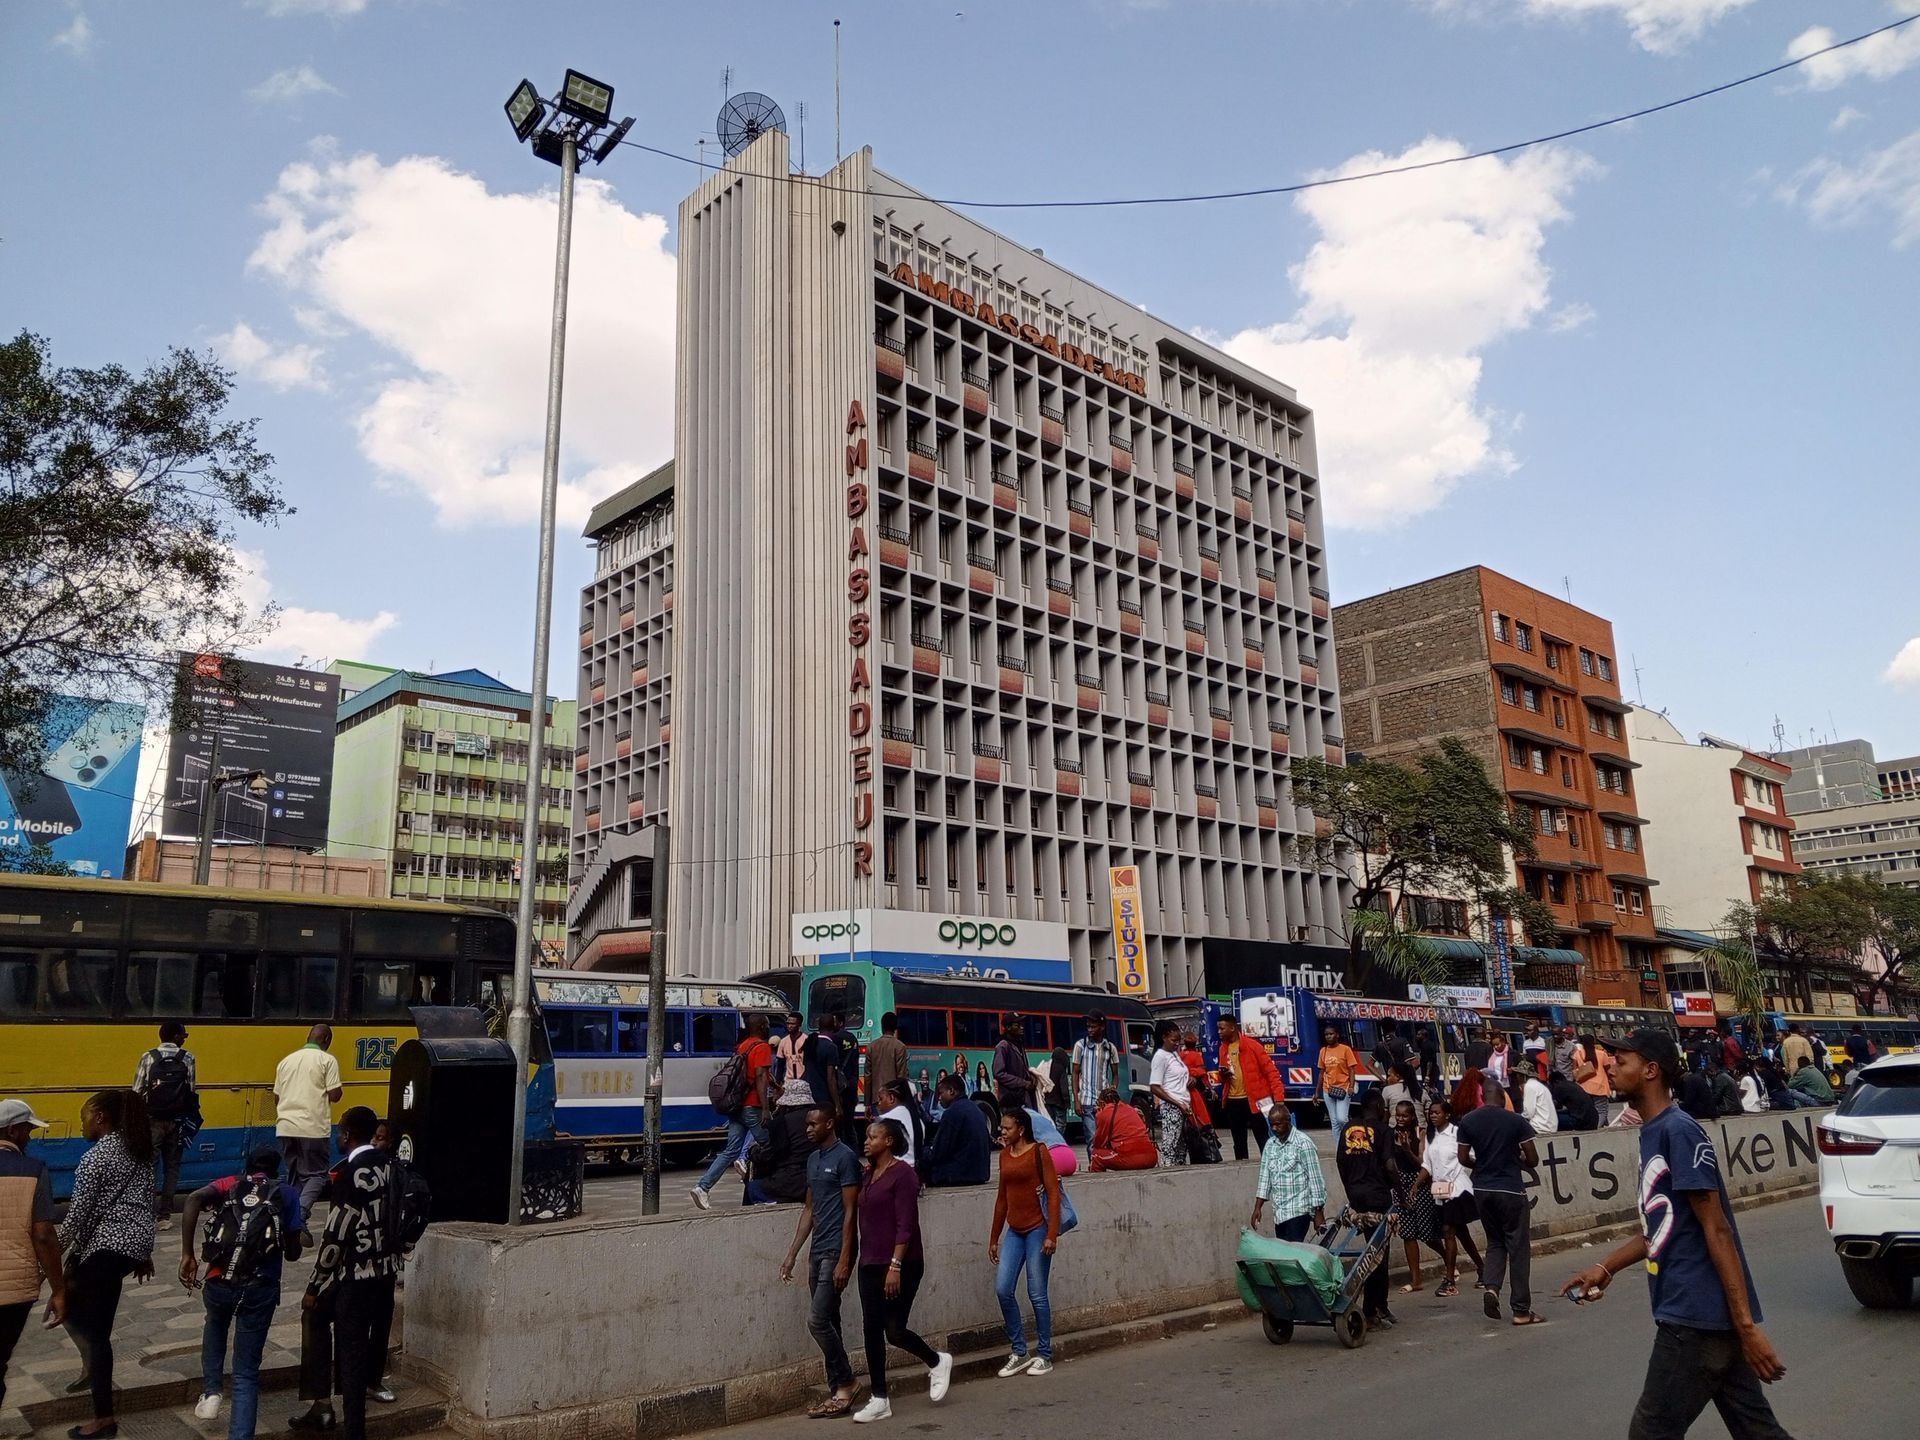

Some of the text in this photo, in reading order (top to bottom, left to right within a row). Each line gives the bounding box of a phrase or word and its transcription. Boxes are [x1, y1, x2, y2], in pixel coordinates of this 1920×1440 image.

[894, 262, 1147, 397] AMBASSADEUR
[846, 400, 873, 877] AMBASSADEUR
[194, 685, 218, 694] World
[239, 691, 259, 700] Solar
[260, 693, 271, 702] PV
[272, 696, 322, 708] Manufacturer
[14, 819, 74, 835] Mobile
[802, 921, 861, 942] oppo
[938, 920, 1017, 950] oppo
[1120, 899, 1142, 988] STUDIO
[1280, 963, 1346, 990] Infinix
[1500, 961, 1510, 996] SCHOOL
[356, 1037, 397, 1070] 125
[581, 1071, 634, 1094] TRANS
[1521, 1136, 1619, 1210] et's
[1721, 1123, 1776, 1178] ke
